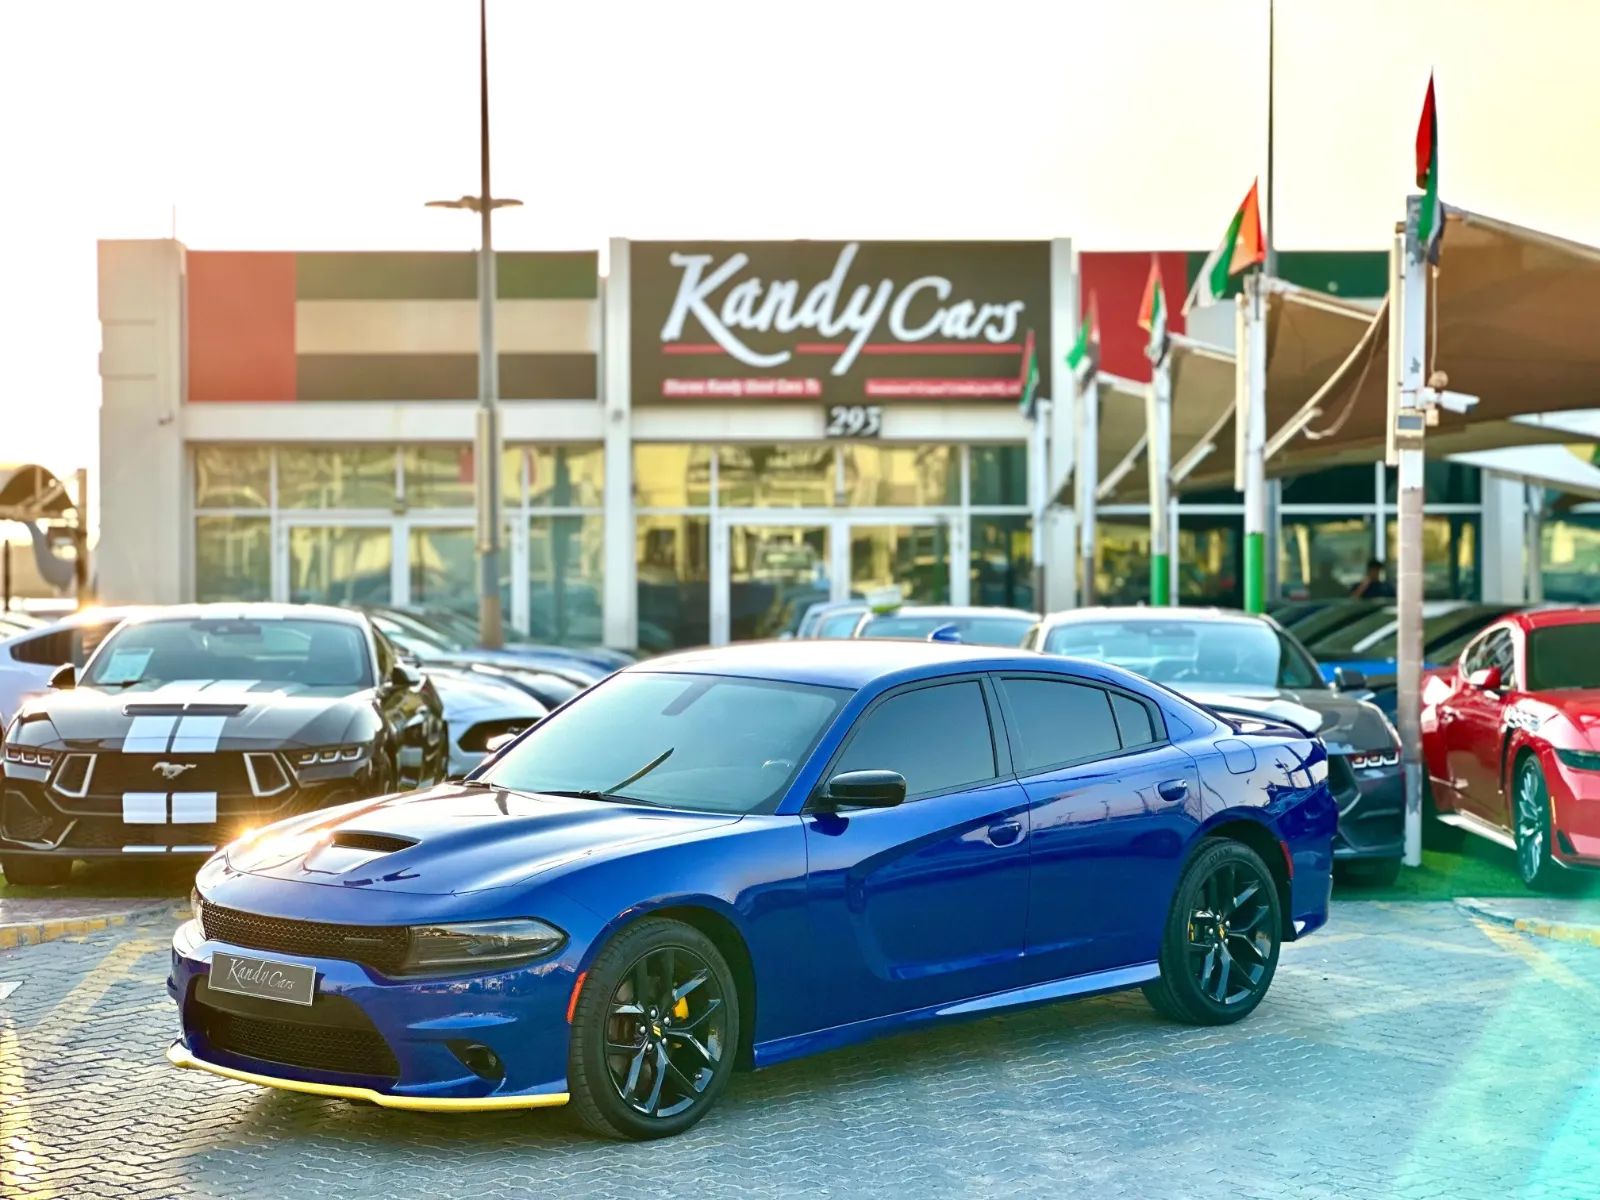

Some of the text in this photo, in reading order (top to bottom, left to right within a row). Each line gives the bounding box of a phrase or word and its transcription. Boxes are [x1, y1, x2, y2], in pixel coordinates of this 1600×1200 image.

[661, 243, 1024, 375] Kandy Cars
[827, 405, 881, 436] 295
[227, 958, 296, 990] Kandy Cars
